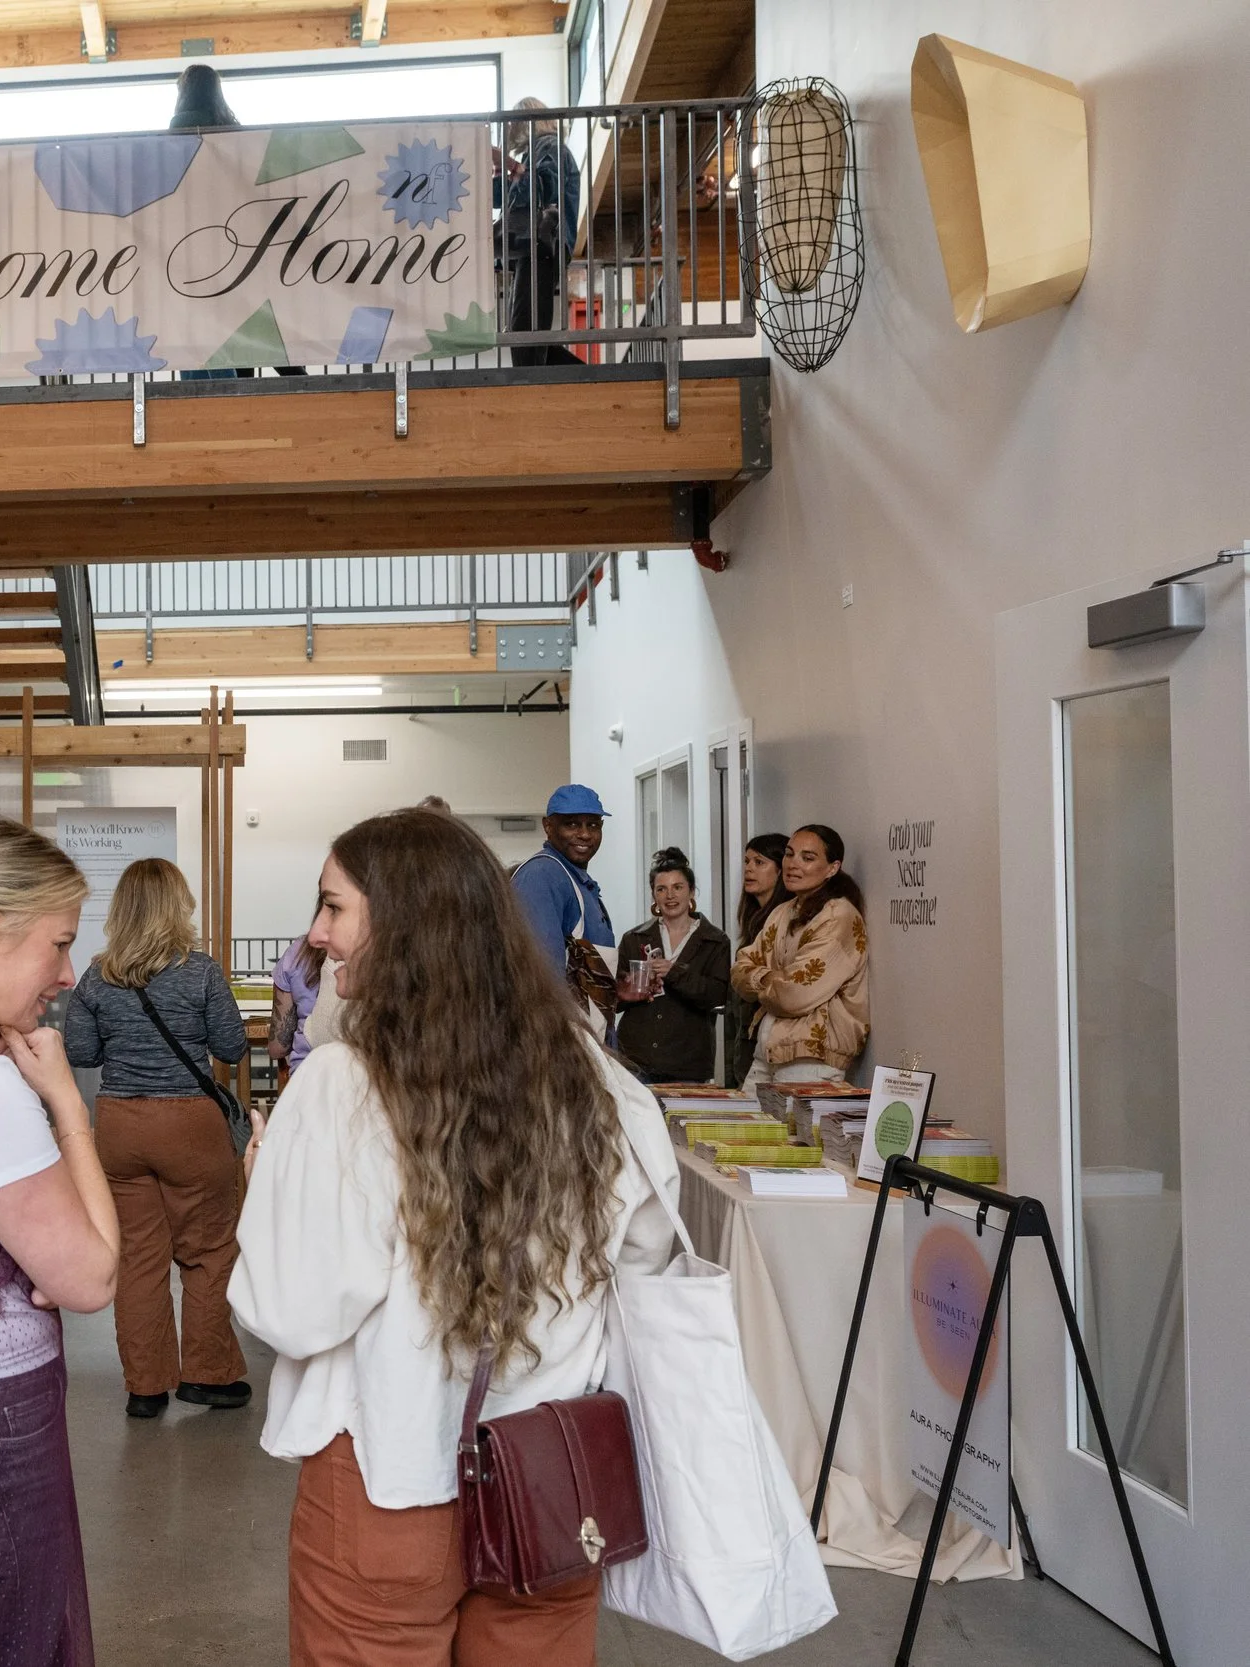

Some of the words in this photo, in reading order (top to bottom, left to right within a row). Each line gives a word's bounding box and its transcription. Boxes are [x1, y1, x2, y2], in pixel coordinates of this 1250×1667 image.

[167, 179, 469, 298] Home
[65, 825, 88, 835] How
[116, 824, 145, 834] Know
[65, 838, 78, 848] It's
[79, 838, 122, 849] Working
[888, 818, 911, 851] Grab
[910, 820, 934, 856] your
[897, 859, 926, 888] Nester
[890, 892, 937, 932] magazine!
[913, 1289, 968, 1325] ILLUMINATE
[970, 1315, 996, 1339] AUA
[936, 1318, 947, 1329] BE
[950, 1324, 971, 1341] SEEN
[910, 1409, 932, 1431] AURA
[935, 1424, 1001, 1473] PHOGRAPHY
